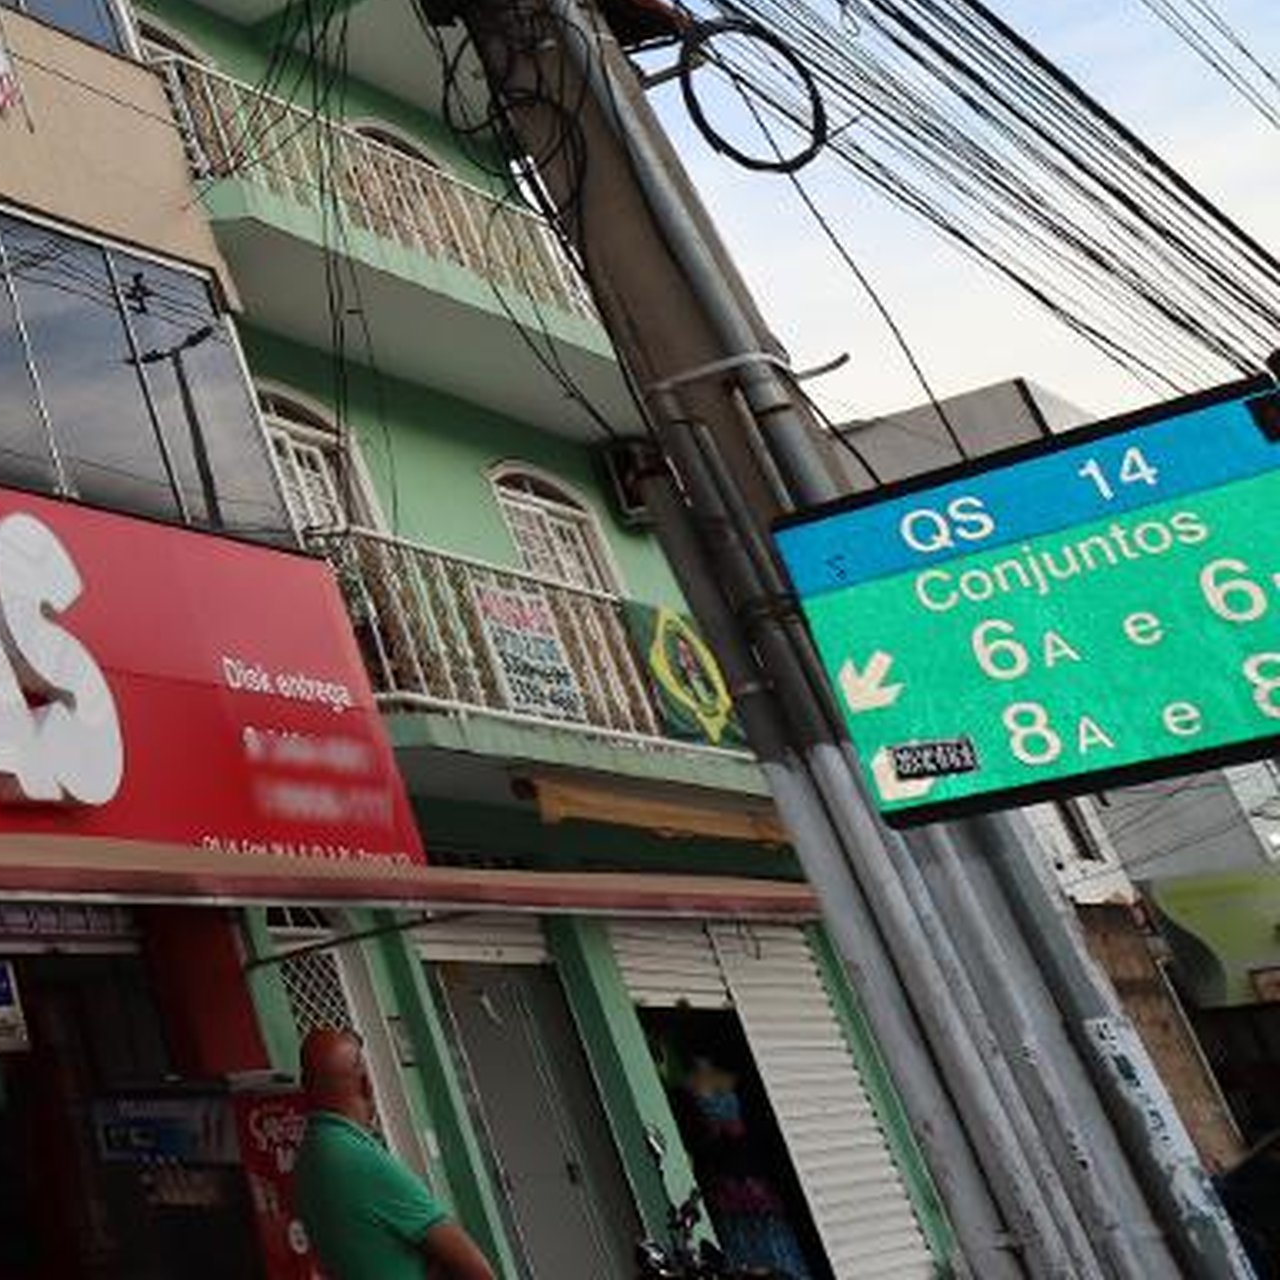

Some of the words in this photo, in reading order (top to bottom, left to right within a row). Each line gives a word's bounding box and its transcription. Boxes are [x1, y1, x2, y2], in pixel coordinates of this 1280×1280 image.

[900, 495, 995, 553] QS
[1077, 446, 1159, 501] 14
[915, 511, 1210, 612] Conjuntos
[1122, 611, 1165, 646] e
[1162, 701, 1203, 736] e
